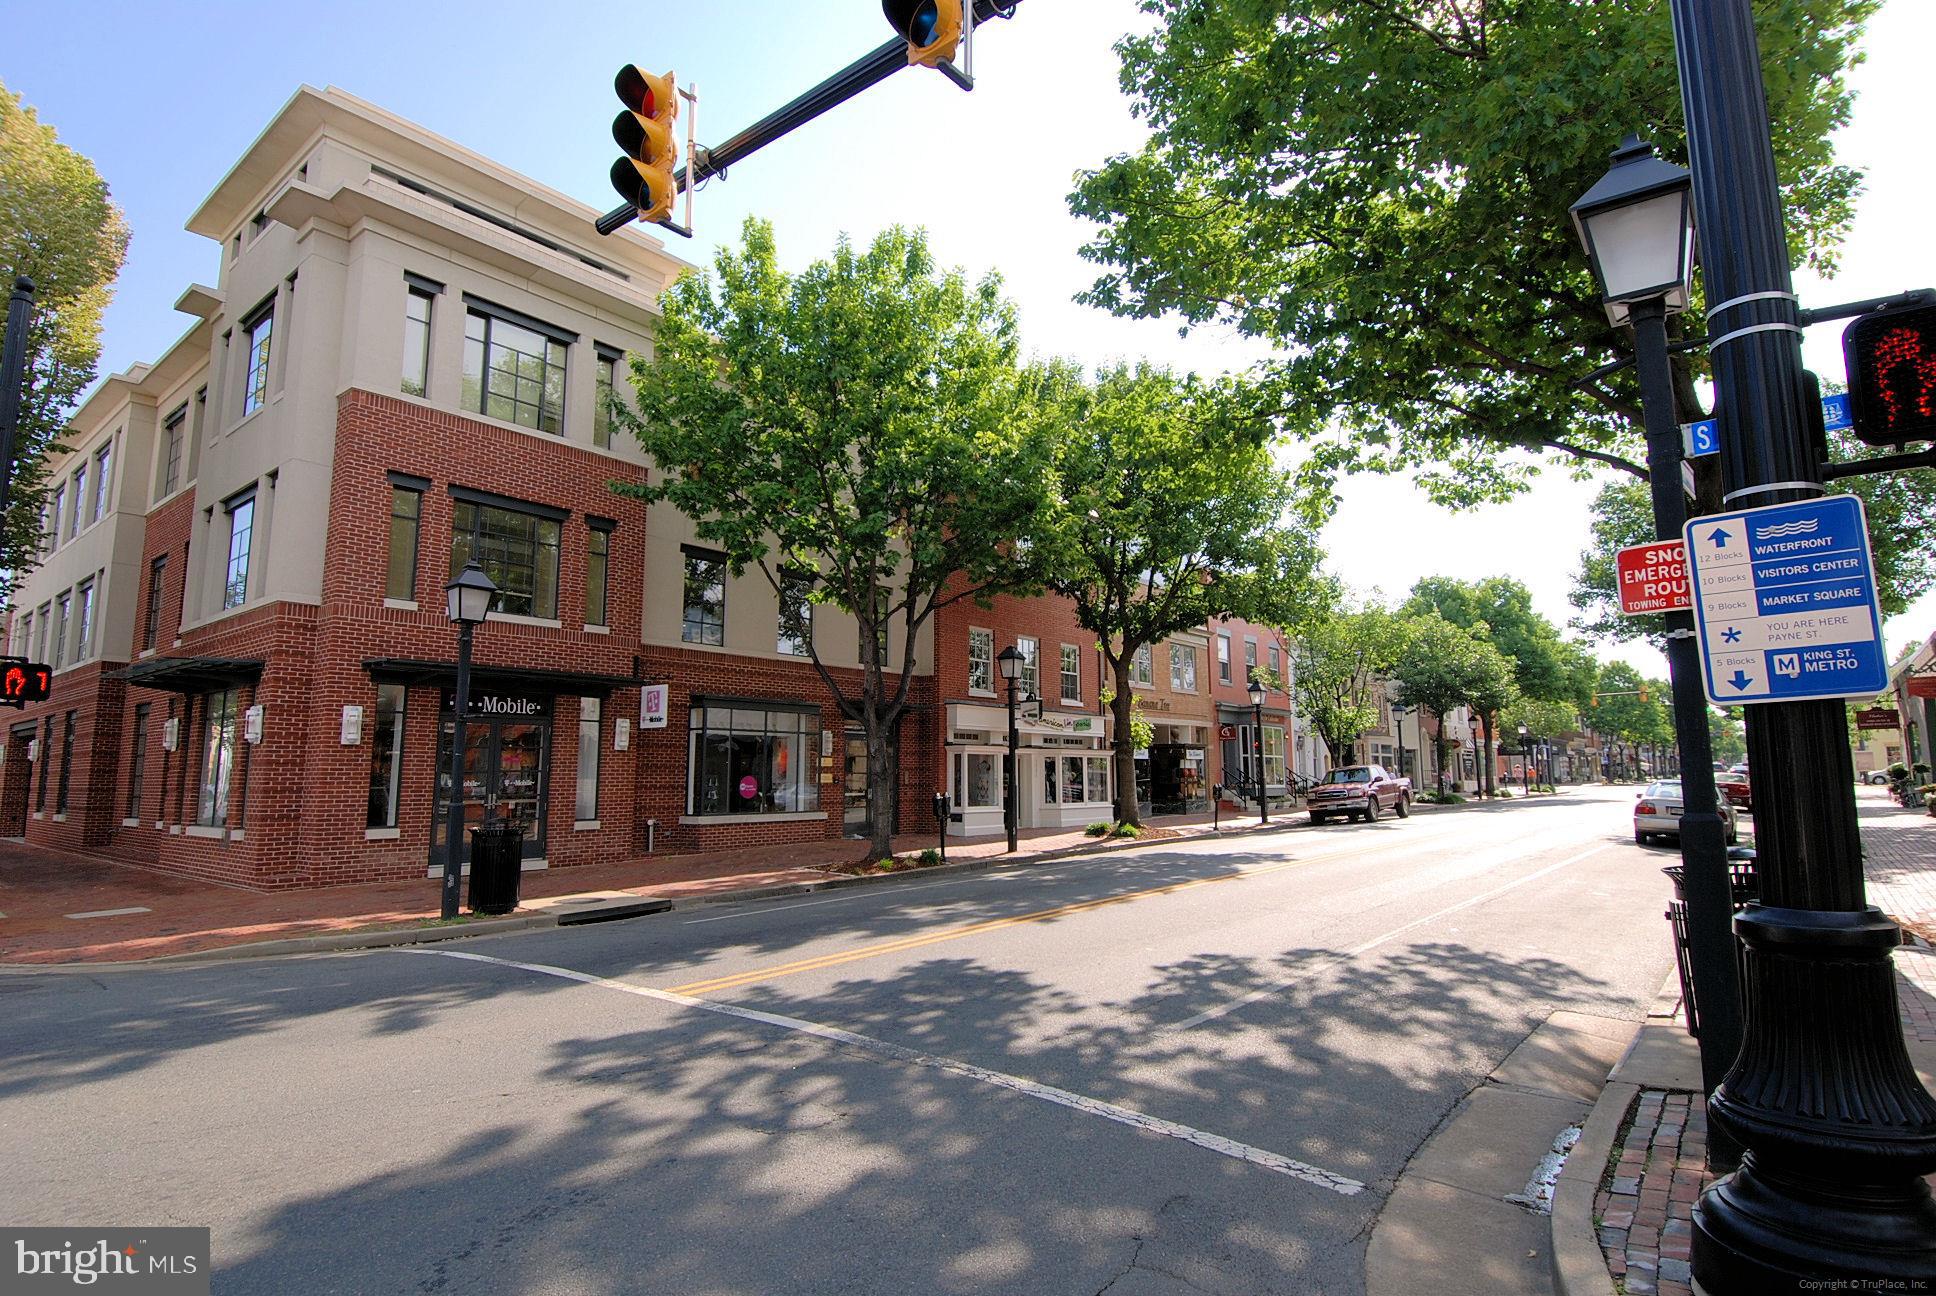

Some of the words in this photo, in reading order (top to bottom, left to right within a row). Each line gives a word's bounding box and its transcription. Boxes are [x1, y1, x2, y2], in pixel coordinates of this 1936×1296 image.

[1697, 425, 1711, 450] S
[1755, 536, 1833, 555] WATERFRONT
[1645, 547, 1686, 565] SNO
[1699, 554, 1711, 563] 12
[1714, 551, 1744, 562] Blocks
[1624, 563, 1689, 584] EMERGE
[1758, 564, 1810, 579] VISITORS
[1812, 558, 1859, 572] CENTER
[1703, 577, 1715, 585] 10
[1717, 574, 1747, 584] Blocks
[1644, 580, 1688, 597] ROU
[1763, 592, 1810, 606] MARKET
[1813, 587, 1862, 601] SQUARE
[1628, 598, 1667, 611] TOWING
[1673, 595, 1690, 606] EN
[1708, 604, 1715, 612] 9
[1718, 601, 1747, 611] Blocks
[1766, 622, 1789, 632] YOU
[1793, 619, 1815, 629] ARE
[1818, 616, 1849, 627] HERE
[1768, 631, 1802, 642] PAYNE
[1716, 659, 1723, 667] 5
[1726, 657, 1756, 666] Blocks
[1803, 650, 1833, 661] KING
[1836, 648, 1855, 658] ST.
[1805, 658, 1859, 673] METRO
